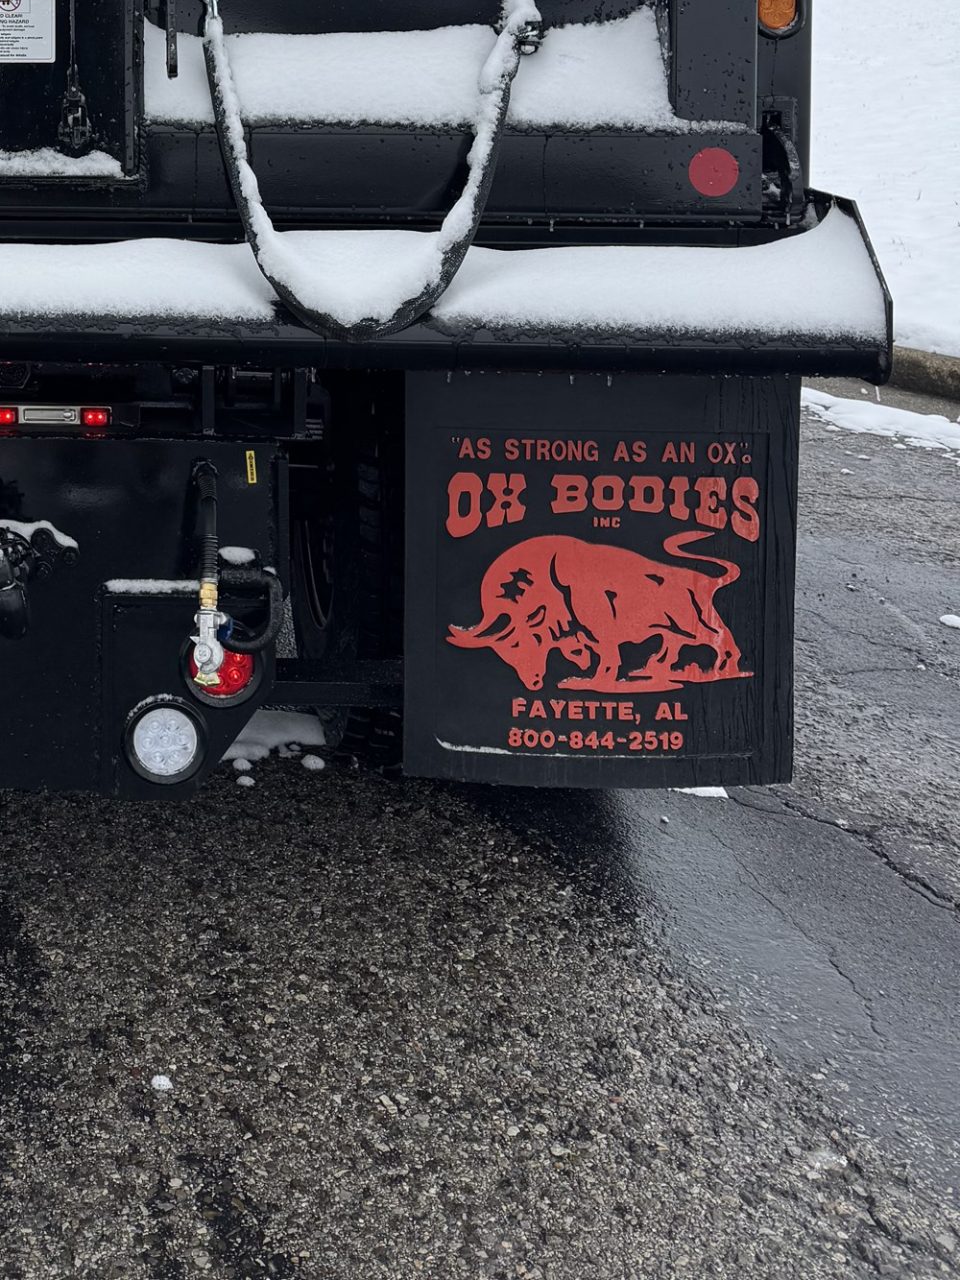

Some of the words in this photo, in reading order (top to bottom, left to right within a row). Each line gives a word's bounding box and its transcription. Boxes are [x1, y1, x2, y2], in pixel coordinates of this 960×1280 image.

[505, 438, 600, 462] STRONG
[613, 440, 647, 463] AS
[662, 441, 696, 464] AN
[445, 471, 527, 539] OX
[550, 474, 760, 542] BODIES
[593, 516, 621, 529] INC
[511, 697, 642, 725] FAYETTE,
[655, 701, 689, 721] AL
[508, 727, 685, 750] 800-844-2519
